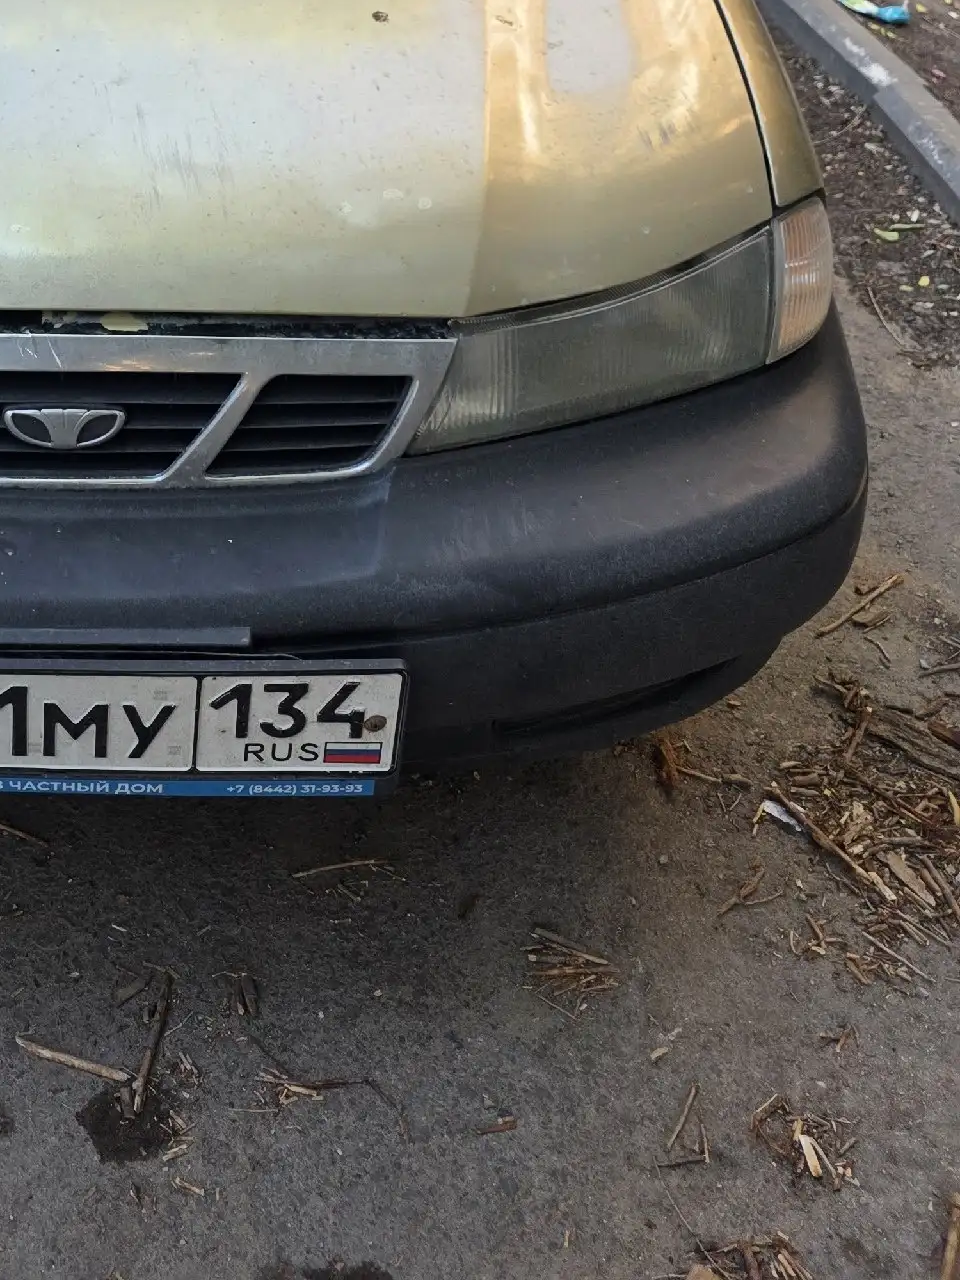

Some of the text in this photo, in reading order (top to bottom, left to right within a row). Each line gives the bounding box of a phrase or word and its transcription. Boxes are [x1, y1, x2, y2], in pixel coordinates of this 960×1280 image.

[209, 681, 366, 739] 134
[243, 742, 320, 762] RUS
[9, 780, 110, 793] ЧАСТНЫЙ
[114, 783, 164, 795] ДОМ
[226, 784, 363, 795] +7 (8442) 31-93-93
